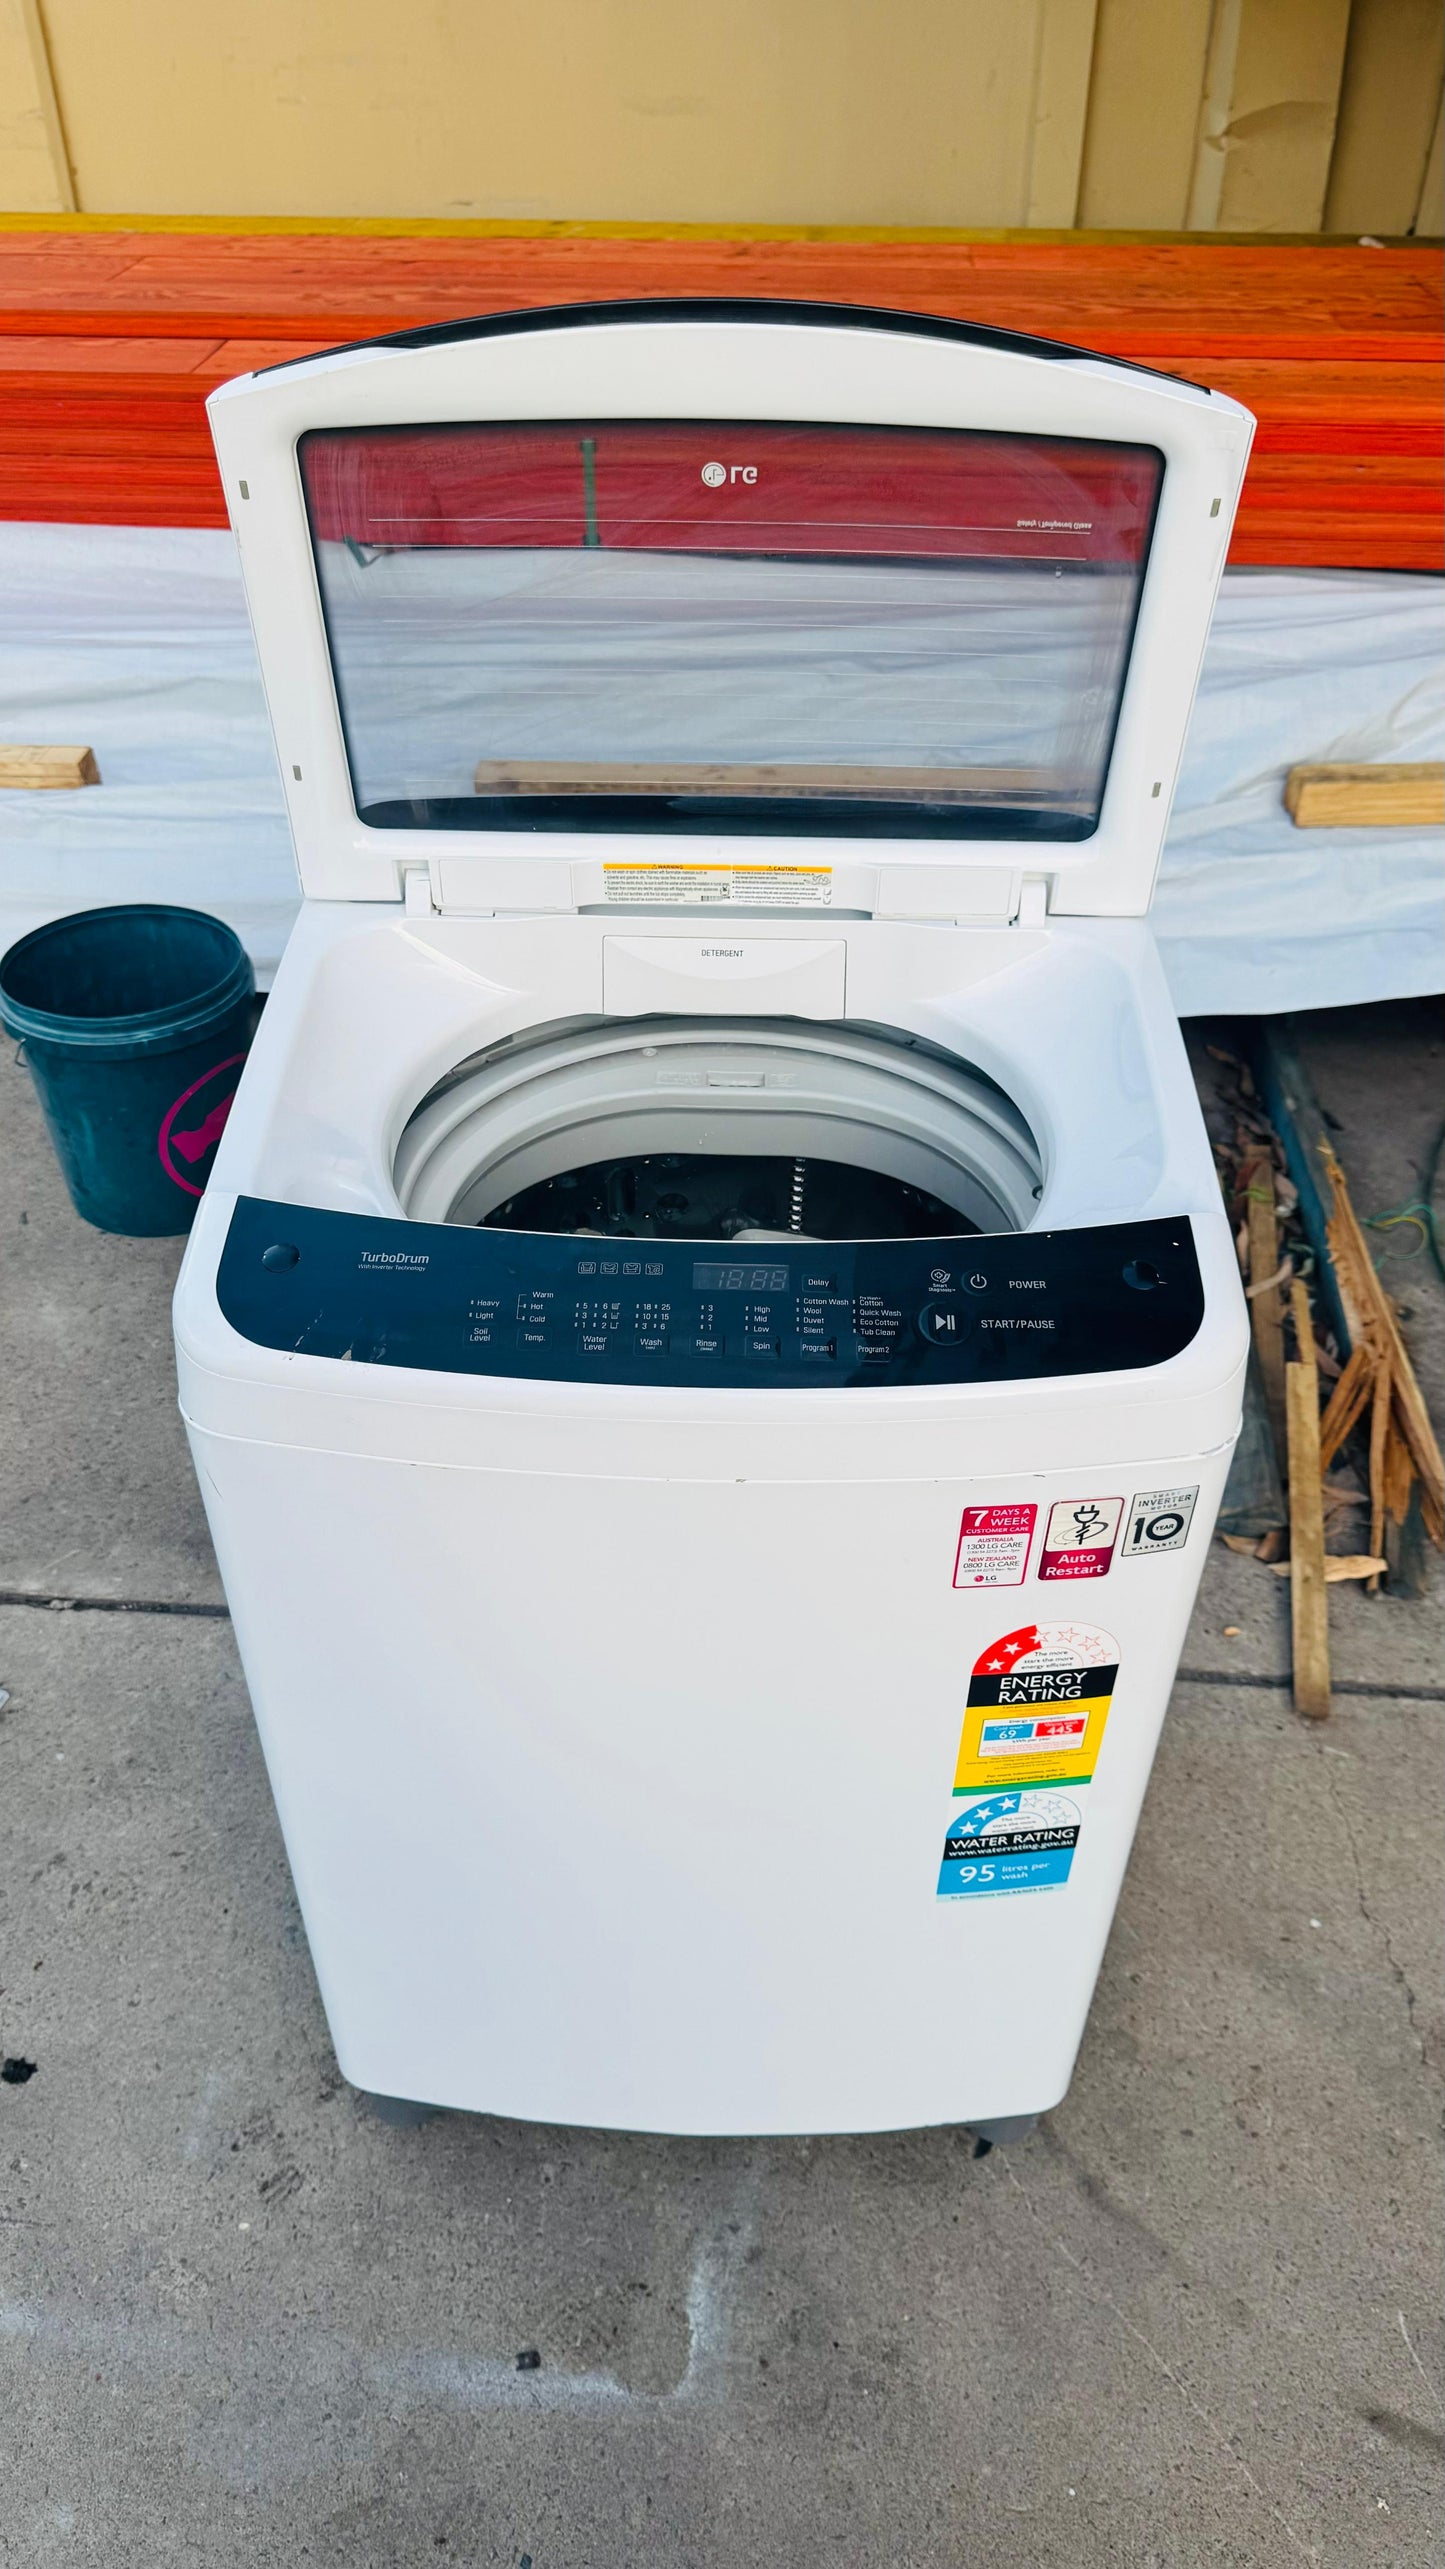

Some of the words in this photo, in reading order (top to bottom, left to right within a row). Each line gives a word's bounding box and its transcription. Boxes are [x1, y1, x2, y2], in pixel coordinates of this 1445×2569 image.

[701, 949, 743, 957] DETERGENT
[361, 1252, 430, 1264] TurboDrum
[808, 1279, 829, 1287] Delay
[1009, 1280, 1046, 1289] POWER
[475, 1312, 494, 1320] Light
[881, 1309, 902, 1317] Wash
[803, 1316, 824, 1324] Duvet
[859, 1318, 874, 1326] Eco
[981, 1320, 1055, 1329] START/PAUSE
[803, 1326, 824, 1334] Silent
[875, 1328, 896, 1336] Clean
[469, 1334, 491, 1342] Level
[525, 1334, 546, 1343] Temp.
[640, 1338, 662, 1346] Wash
[695, 1339, 717, 1347] Rinse
[752, 1341, 771, 1349] Spin
[802, 1343, 829, 1352] Program
[857, 1344, 885, 1354] Program
[1138, 1494, 1191, 1507] INVERTER
[992, 1508, 1020, 1517] DAYS
[969, 1510, 989, 1527] 7
[991, 1516, 1030, 1526] WEEK
[1133, 1513, 1184, 1544] 10
[1000, 1541, 1023, 1549] CARE
[1132, 1541, 1177, 1551] WARRANTY
[1058, 1554, 1096, 1564] Auto
[1045, 1564, 1104, 1576] Restart
[1000, 1671, 1087, 1690] ENERGY
[998, 1686, 1082, 1703] RATING
[1047, 1724, 1074, 1735] 445
[999, 1730, 1017, 1739] 69
[951, 1837, 1008, 1849] WATER
[1013, 1828, 1075, 1845] RATING
[948, 1839, 1074, 1857] www.waterrating.gov.au
[1002, 1864, 1029, 1872] litres
[1031, 1862, 1051, 1871] per
[959, 1864, 996, 1883] 95
[1001, 1872, 1029, 1880] wash
